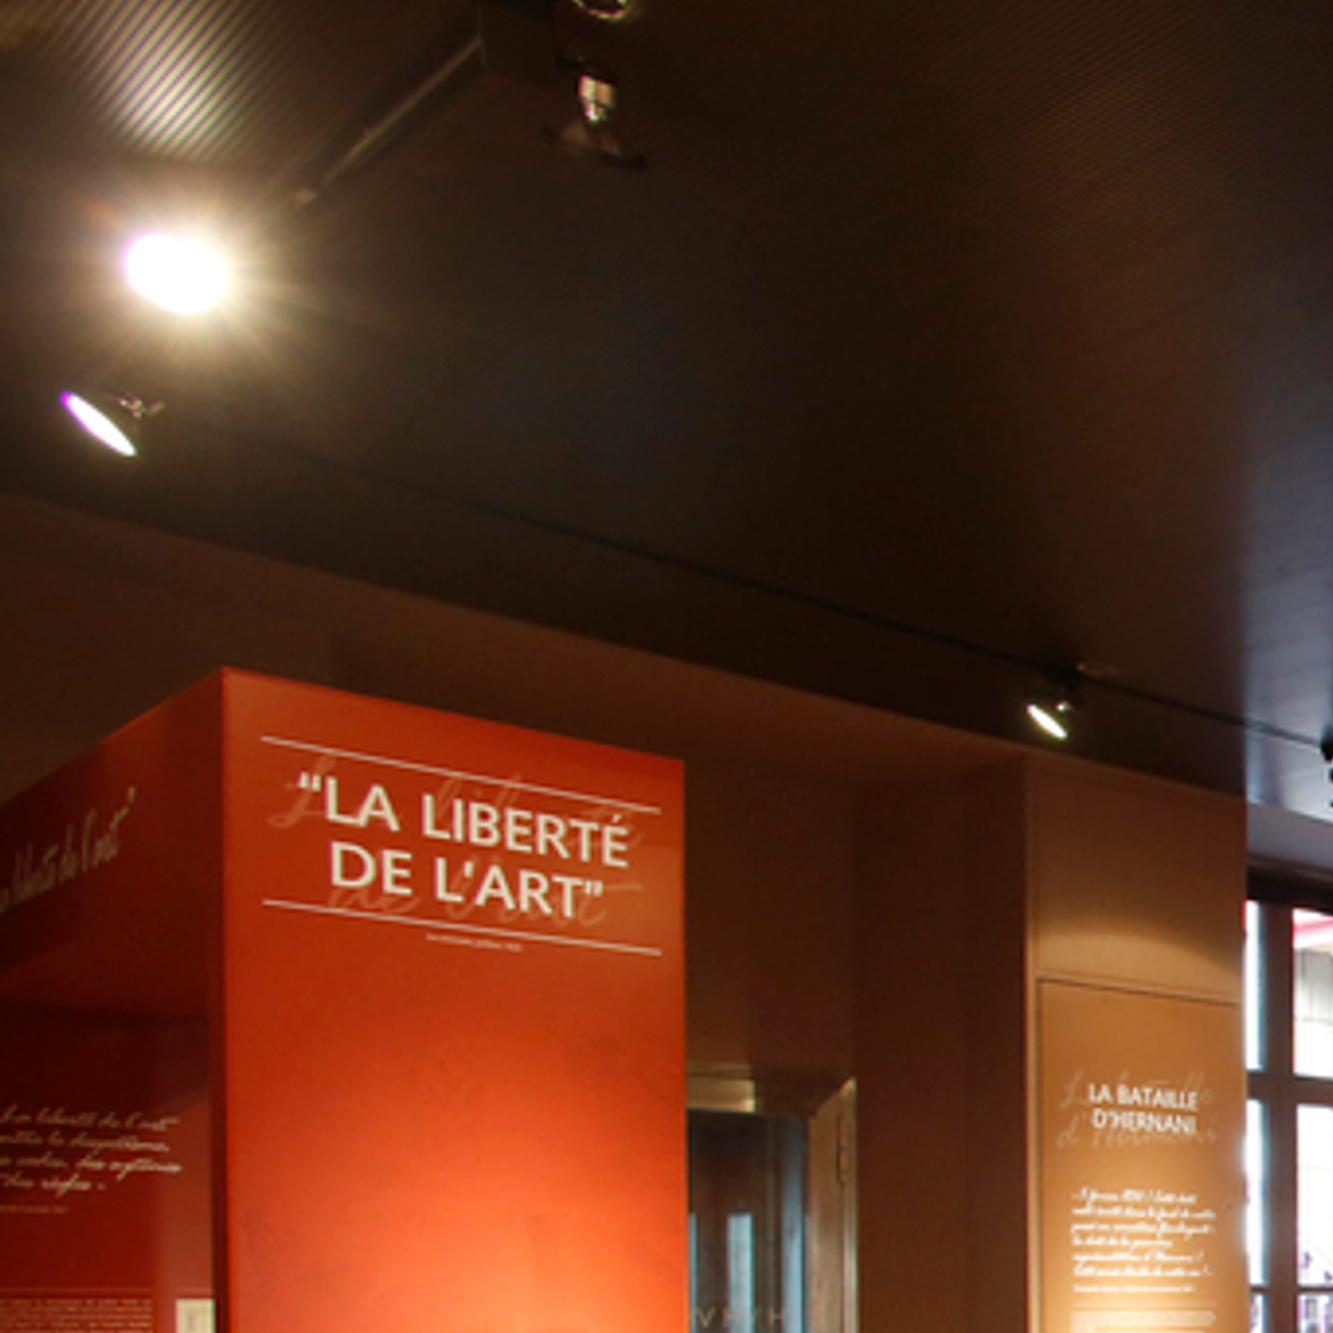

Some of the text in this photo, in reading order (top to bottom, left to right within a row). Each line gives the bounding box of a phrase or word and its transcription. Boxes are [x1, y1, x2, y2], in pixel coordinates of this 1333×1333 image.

[423, 794, 629, 868] LIBERTÉ
[331, 841, 412, 896] DE
[1089, 1082, 1198, 1112] LA BATAILLE
[1092, 1107, 1197, 1135] D'HERNANI
